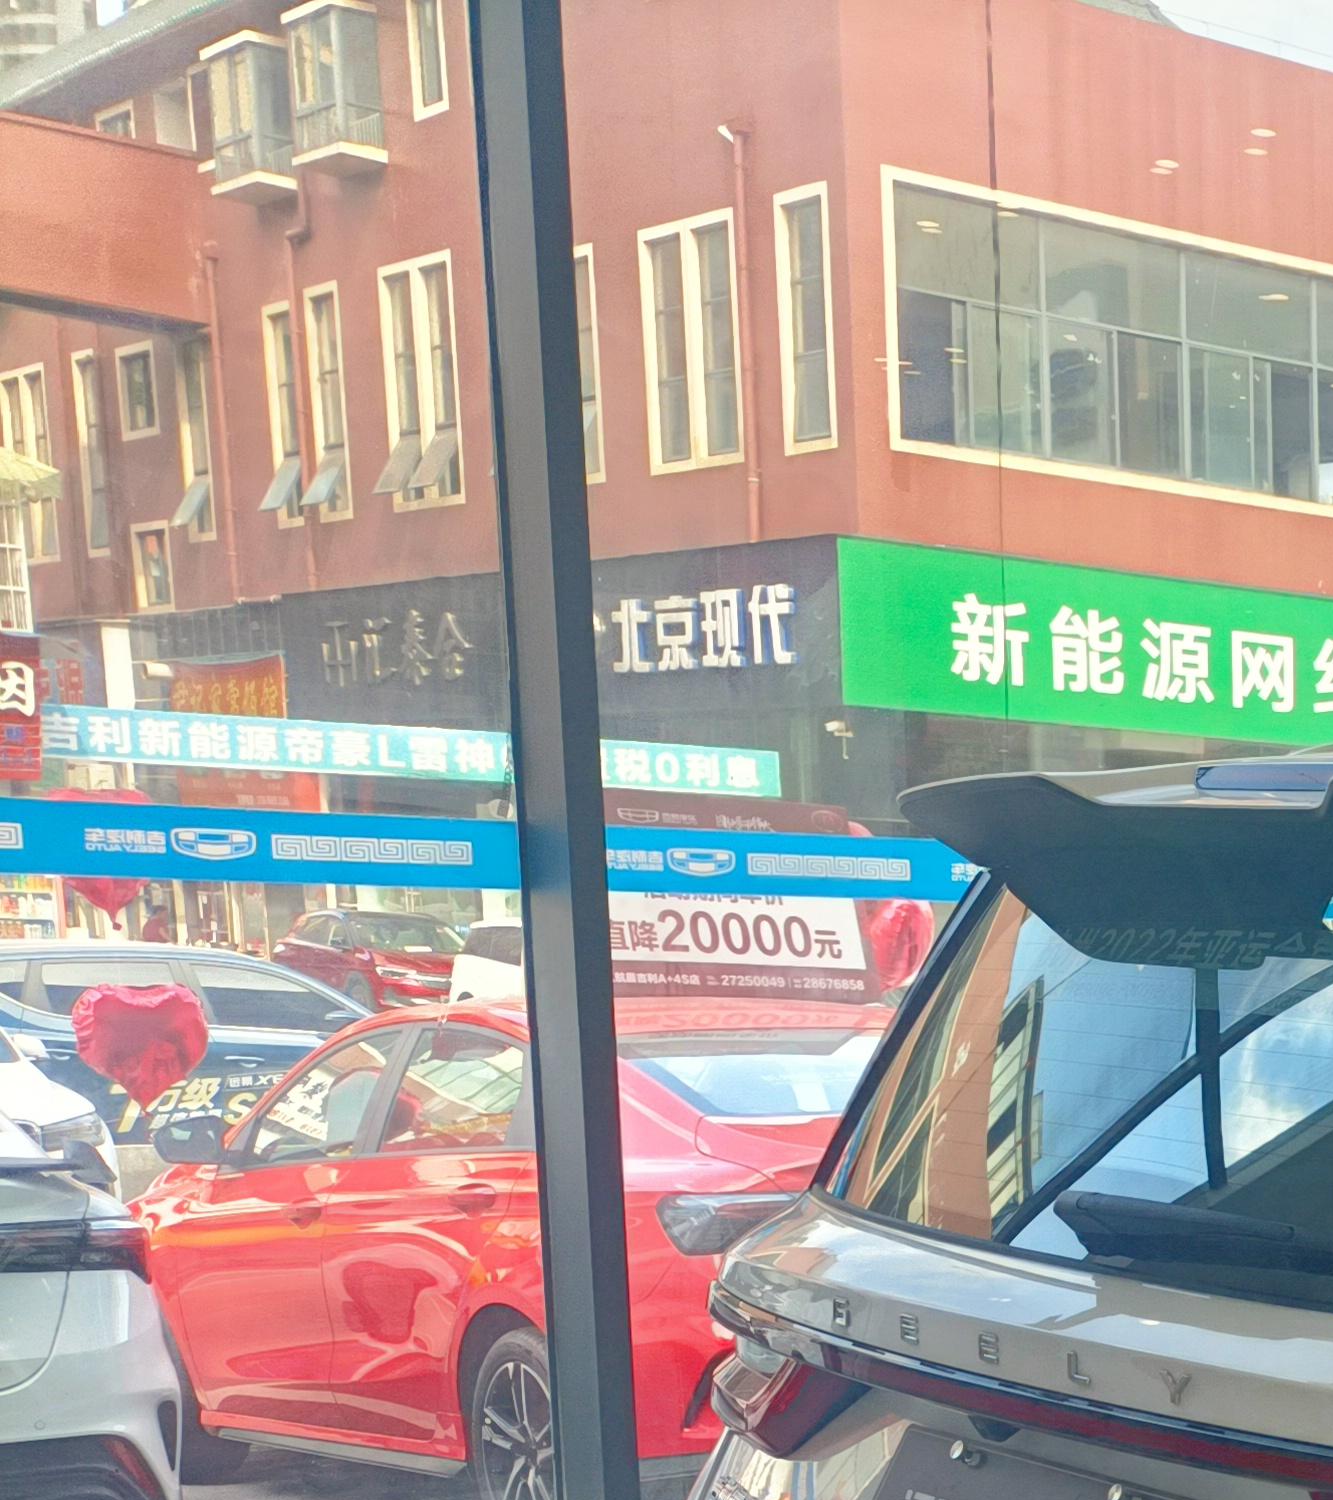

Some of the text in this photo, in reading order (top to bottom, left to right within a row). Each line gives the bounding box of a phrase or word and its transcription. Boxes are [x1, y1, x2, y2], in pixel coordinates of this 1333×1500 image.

[612, 583, 798, 674] 北京现代
[831, 1296, 1192, 1405] GEELY
